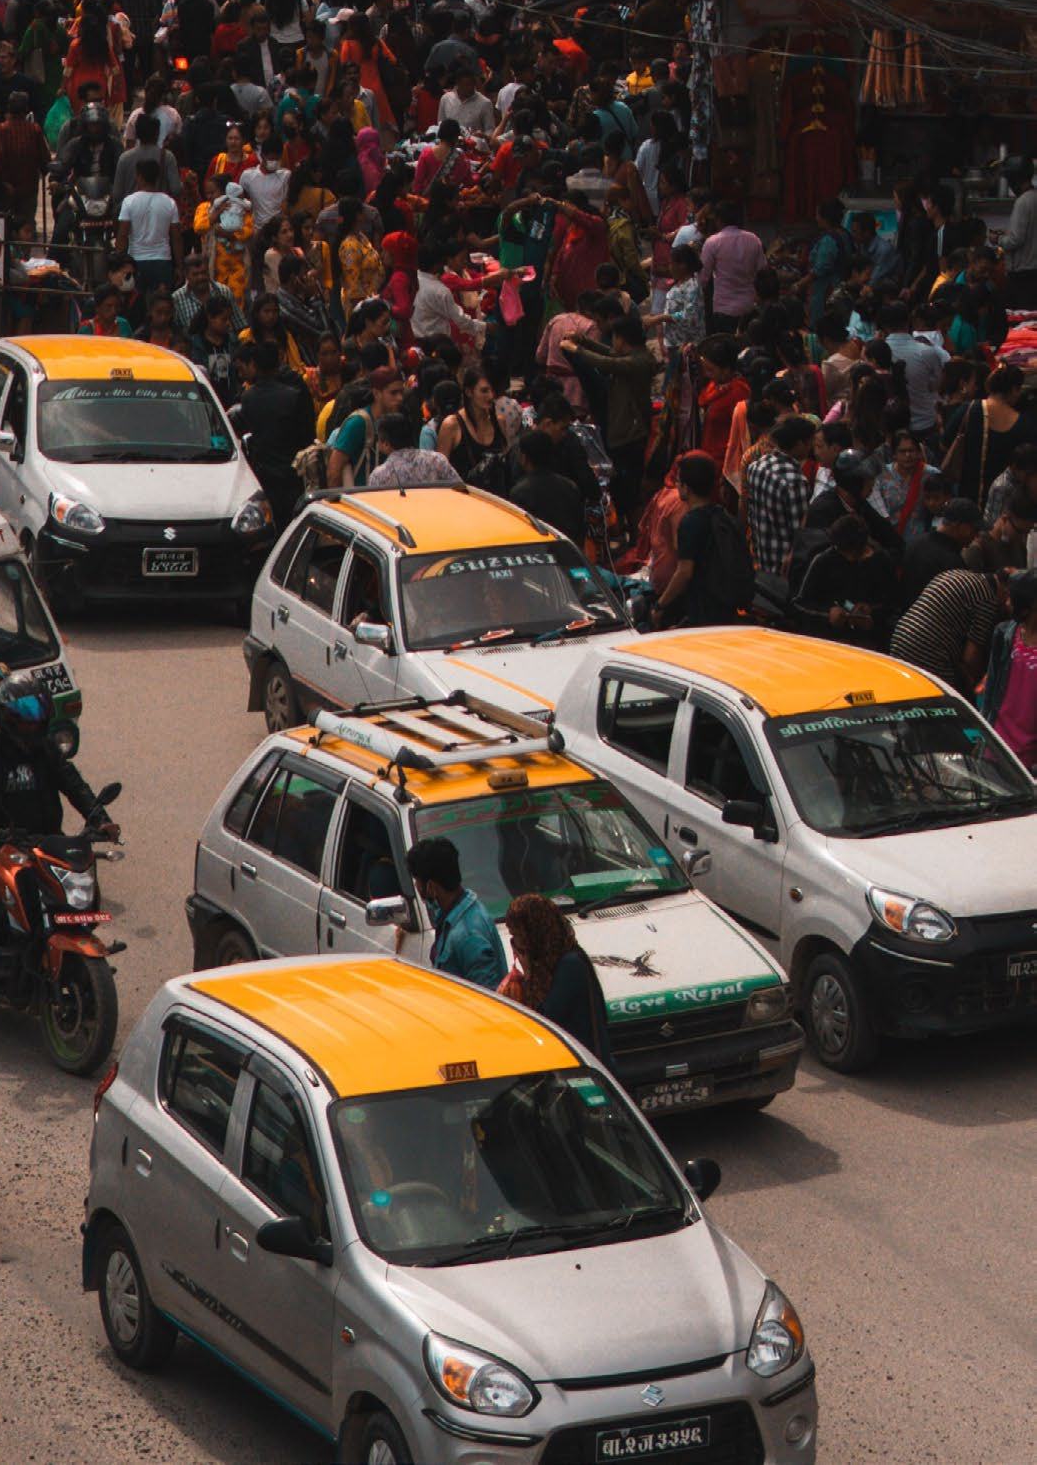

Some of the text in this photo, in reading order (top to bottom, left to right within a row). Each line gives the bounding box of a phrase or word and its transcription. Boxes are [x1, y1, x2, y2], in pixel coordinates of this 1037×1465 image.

[448, 554, 558, 575] SUZUKI
[488, 569, 513, 580] TAXI
[609, 981, 745, 1015] Love Nepal
[447, 1062, 477, 1079] TAXI
